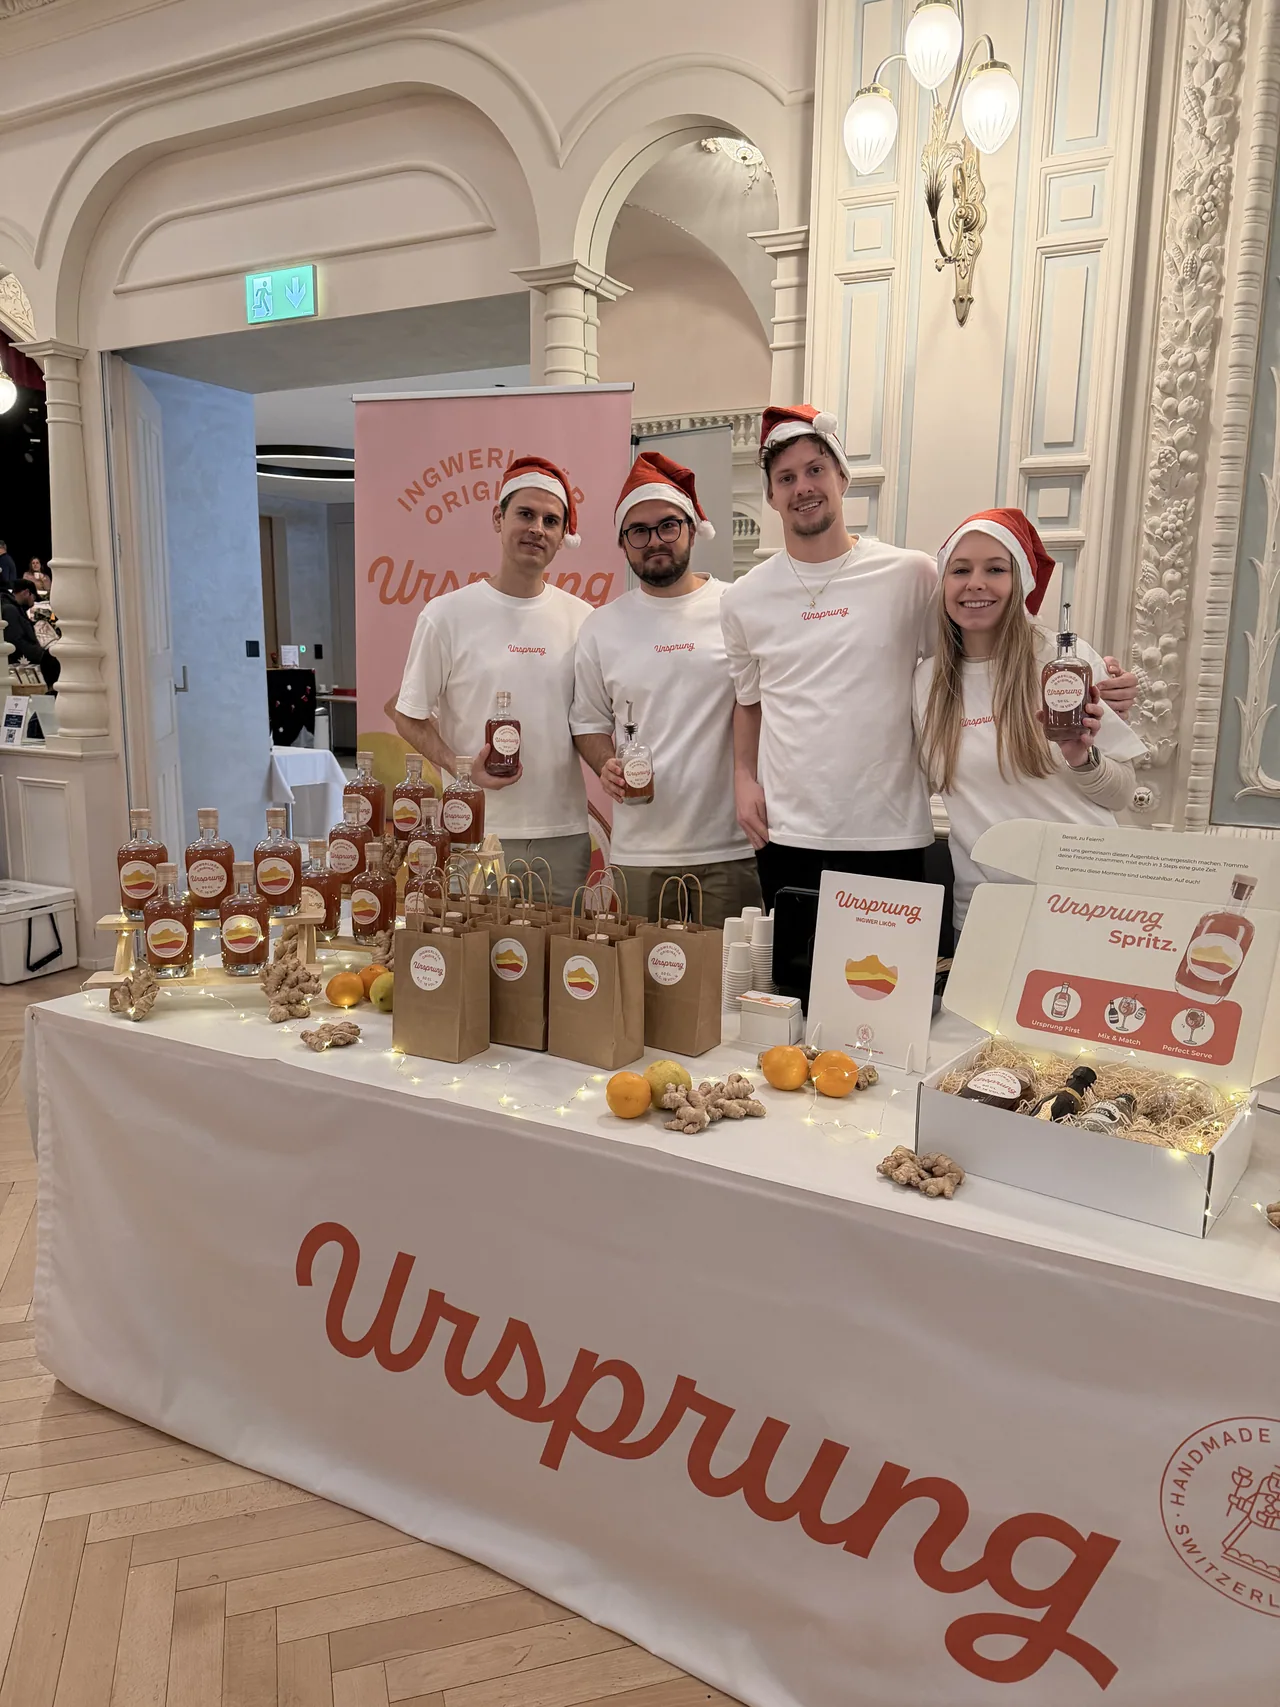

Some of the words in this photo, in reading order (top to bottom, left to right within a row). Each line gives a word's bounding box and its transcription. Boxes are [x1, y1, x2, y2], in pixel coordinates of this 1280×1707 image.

[802, 607, 849, 620] Ursprung
[508, 644, 546, 656] Ursprung
[654, 642, 695, 652] Ursprung
[835, 890, 922, 924] Ursprung
[1047, 894, 1164, 932] Ursprung
[1108, 930, 1177, 952] Spritz.
[413, 961, 443, 976] Ursprung
[651, 958, 684, 970] Ursprung
[1031, 1020, 1063, 1032] Ursprung
[1065, 1026, 1080, 1034] First
[1119, 1036, 1141, 1046] Match
[1162, 1044, 1189, 1055] Perfect
[1191, 1050, 1213, 1059] Serve
[296, 1222, 1122, 1690] Ursprung
[1170, 1428, 1270, 1506] HANDMADE
[1175, 1524, 1280, 1608] SWITZERL
